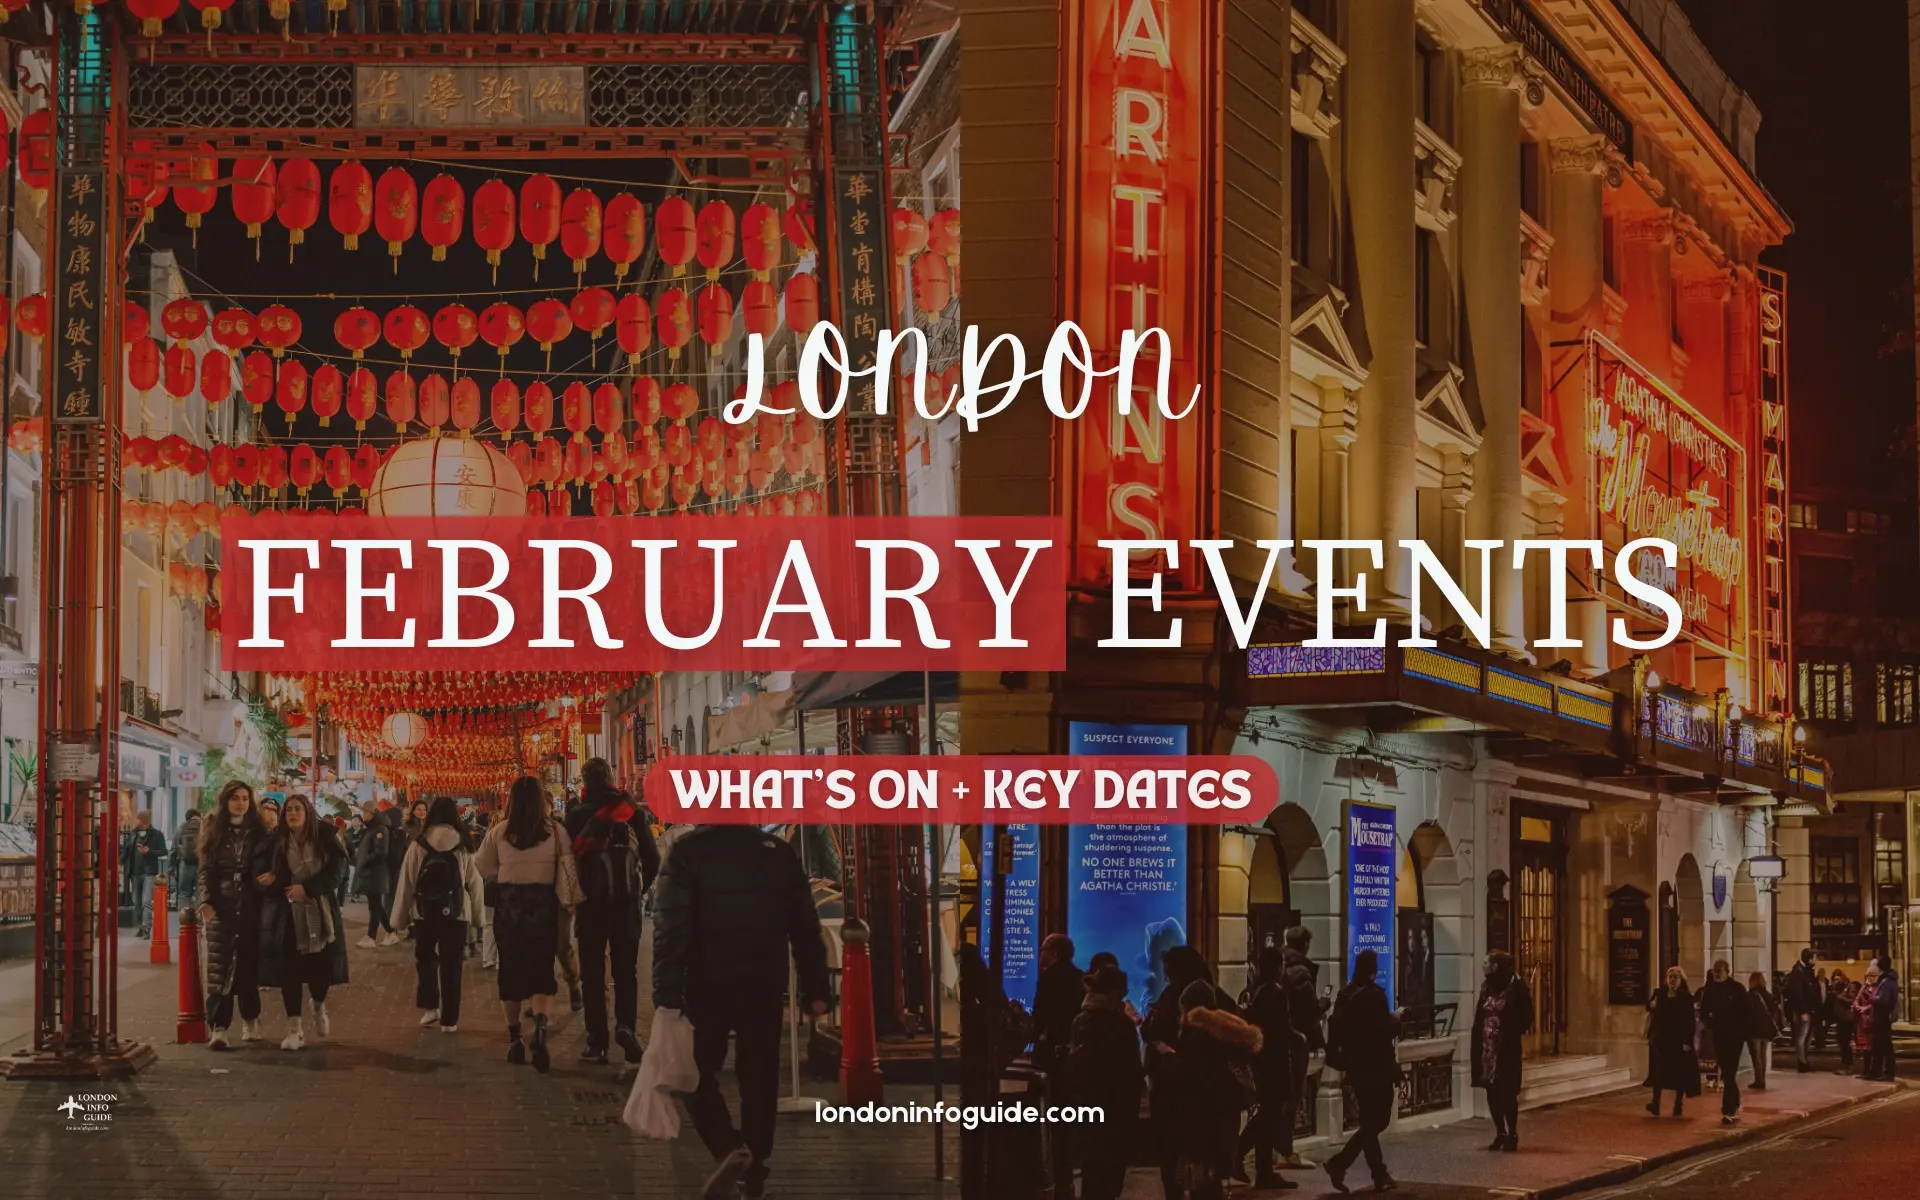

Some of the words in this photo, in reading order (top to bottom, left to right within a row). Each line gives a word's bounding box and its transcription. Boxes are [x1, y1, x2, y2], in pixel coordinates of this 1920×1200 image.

[1511, 6, 1566, 82] MARTINS
[1574, 72, 1625, 144] THEATRE
[1761, 292, 1782, 377] ST
[1615, 369, 1667, 436] AGATHA
[1600, 420, 1742, 604] Mousetrap
[1083, 734, 1123, 743] SUSPECT
[1127, 735, 1174, 745] EVERYONE
[1135, 824, 1151, 832] plot
[1351, 816, 1393, 847] MOUSETRAP
[1106, 834, 1156, 843] atmosphere
[1084, 844, 1131, 853] shuddering
[1082, 858, 1099, 866] NO
[1102, 858, 1125, 867] ONE
[1129, 858, 1164, 867] BREWS
[1167, 858, 1176, 867] IT
[1094, 870, 1130, 878] BETTER
[1134, 870, 1163, 878] THAN
[1080, 881, 1122, 890] AGATHA
[1813, 917, 1854, 926] DISHOOM
